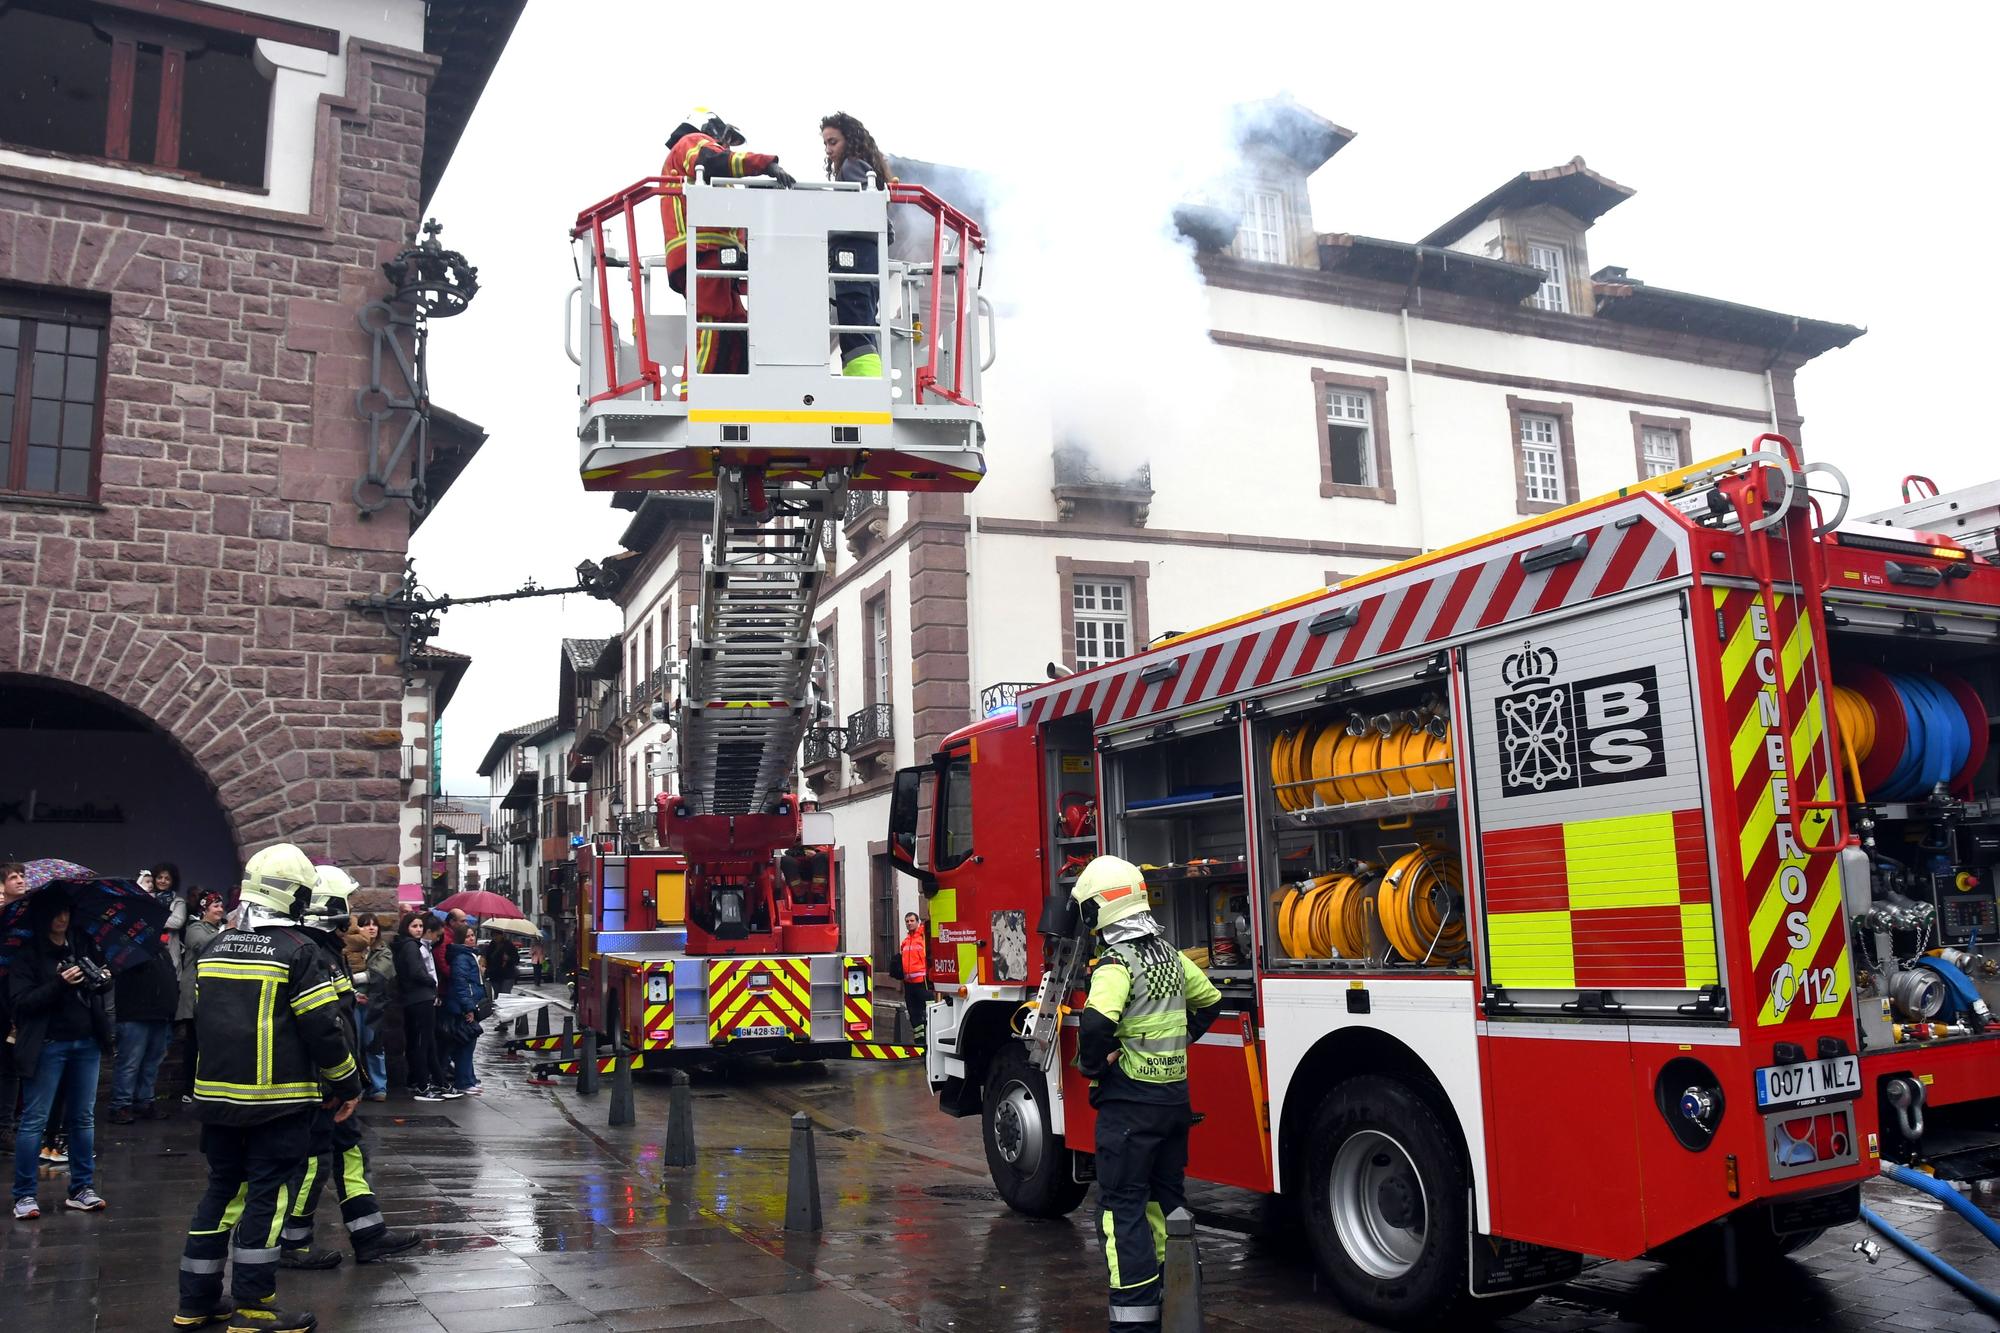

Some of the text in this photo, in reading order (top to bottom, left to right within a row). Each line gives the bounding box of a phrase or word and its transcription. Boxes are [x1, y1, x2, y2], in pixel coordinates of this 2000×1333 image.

[222, 933, 272, 944] BOMBEROS
[934, 959, 956, 973] B-0732
[1798, 967, 1838, 1005] 112
[1147, 1055, 1185, 1066] BOMBEROS
[1770, 1060, 1856, 1098] 0071 MLZ
